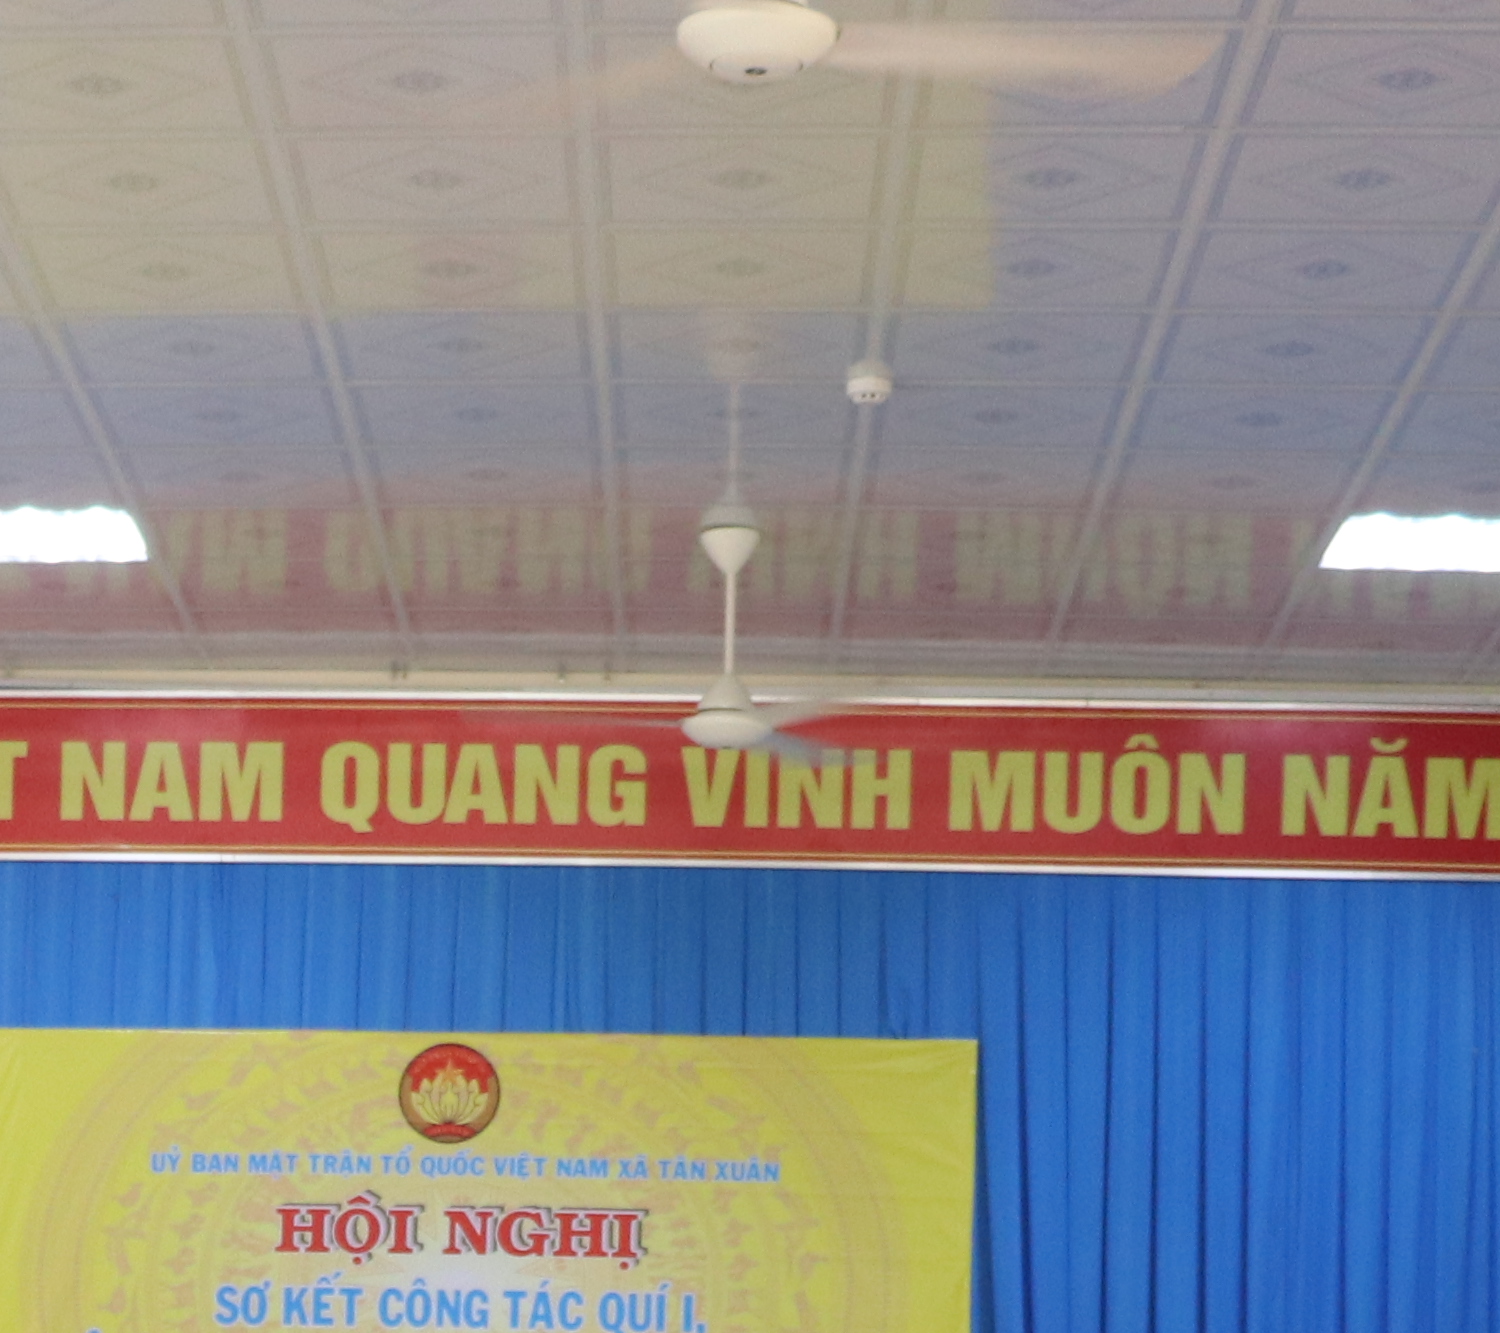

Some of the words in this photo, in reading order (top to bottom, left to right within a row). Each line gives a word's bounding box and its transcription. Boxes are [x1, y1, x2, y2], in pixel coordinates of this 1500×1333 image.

[61, 741, 284, 821] NAM
[321, 741, 647, 832] QUANG
[682, 737, 912, 829] VINH
[949, 734, 1246, 834] MUÔN
[191, 1152, 241, 1174] BAN
[308, 1149, 373, 1178] TRẬN
[379, 1144, 414, 1177] TỔ
[419, 1149, 486, 1179] QUỐC
[492, 1151, 549, 1181] VIỆT
[556, 1157, 610, 1178] NAM
[617, 1154, 650, 1180] XÃ
[656, 1154, 709, 1181] TÂN
[713, 1156, 781, 1183] XUÂN
[275, 1190, 422, 1265] HỘI
[443, 1204, 647, 1271] NGHỊ
[214, 1279, 273, 1326] SƠ
[283, 1271, 365, 1327] KẾT
[379, 1278, 490, 1329] CÔNG
[502, 1280, 584, 1331] TÁC
